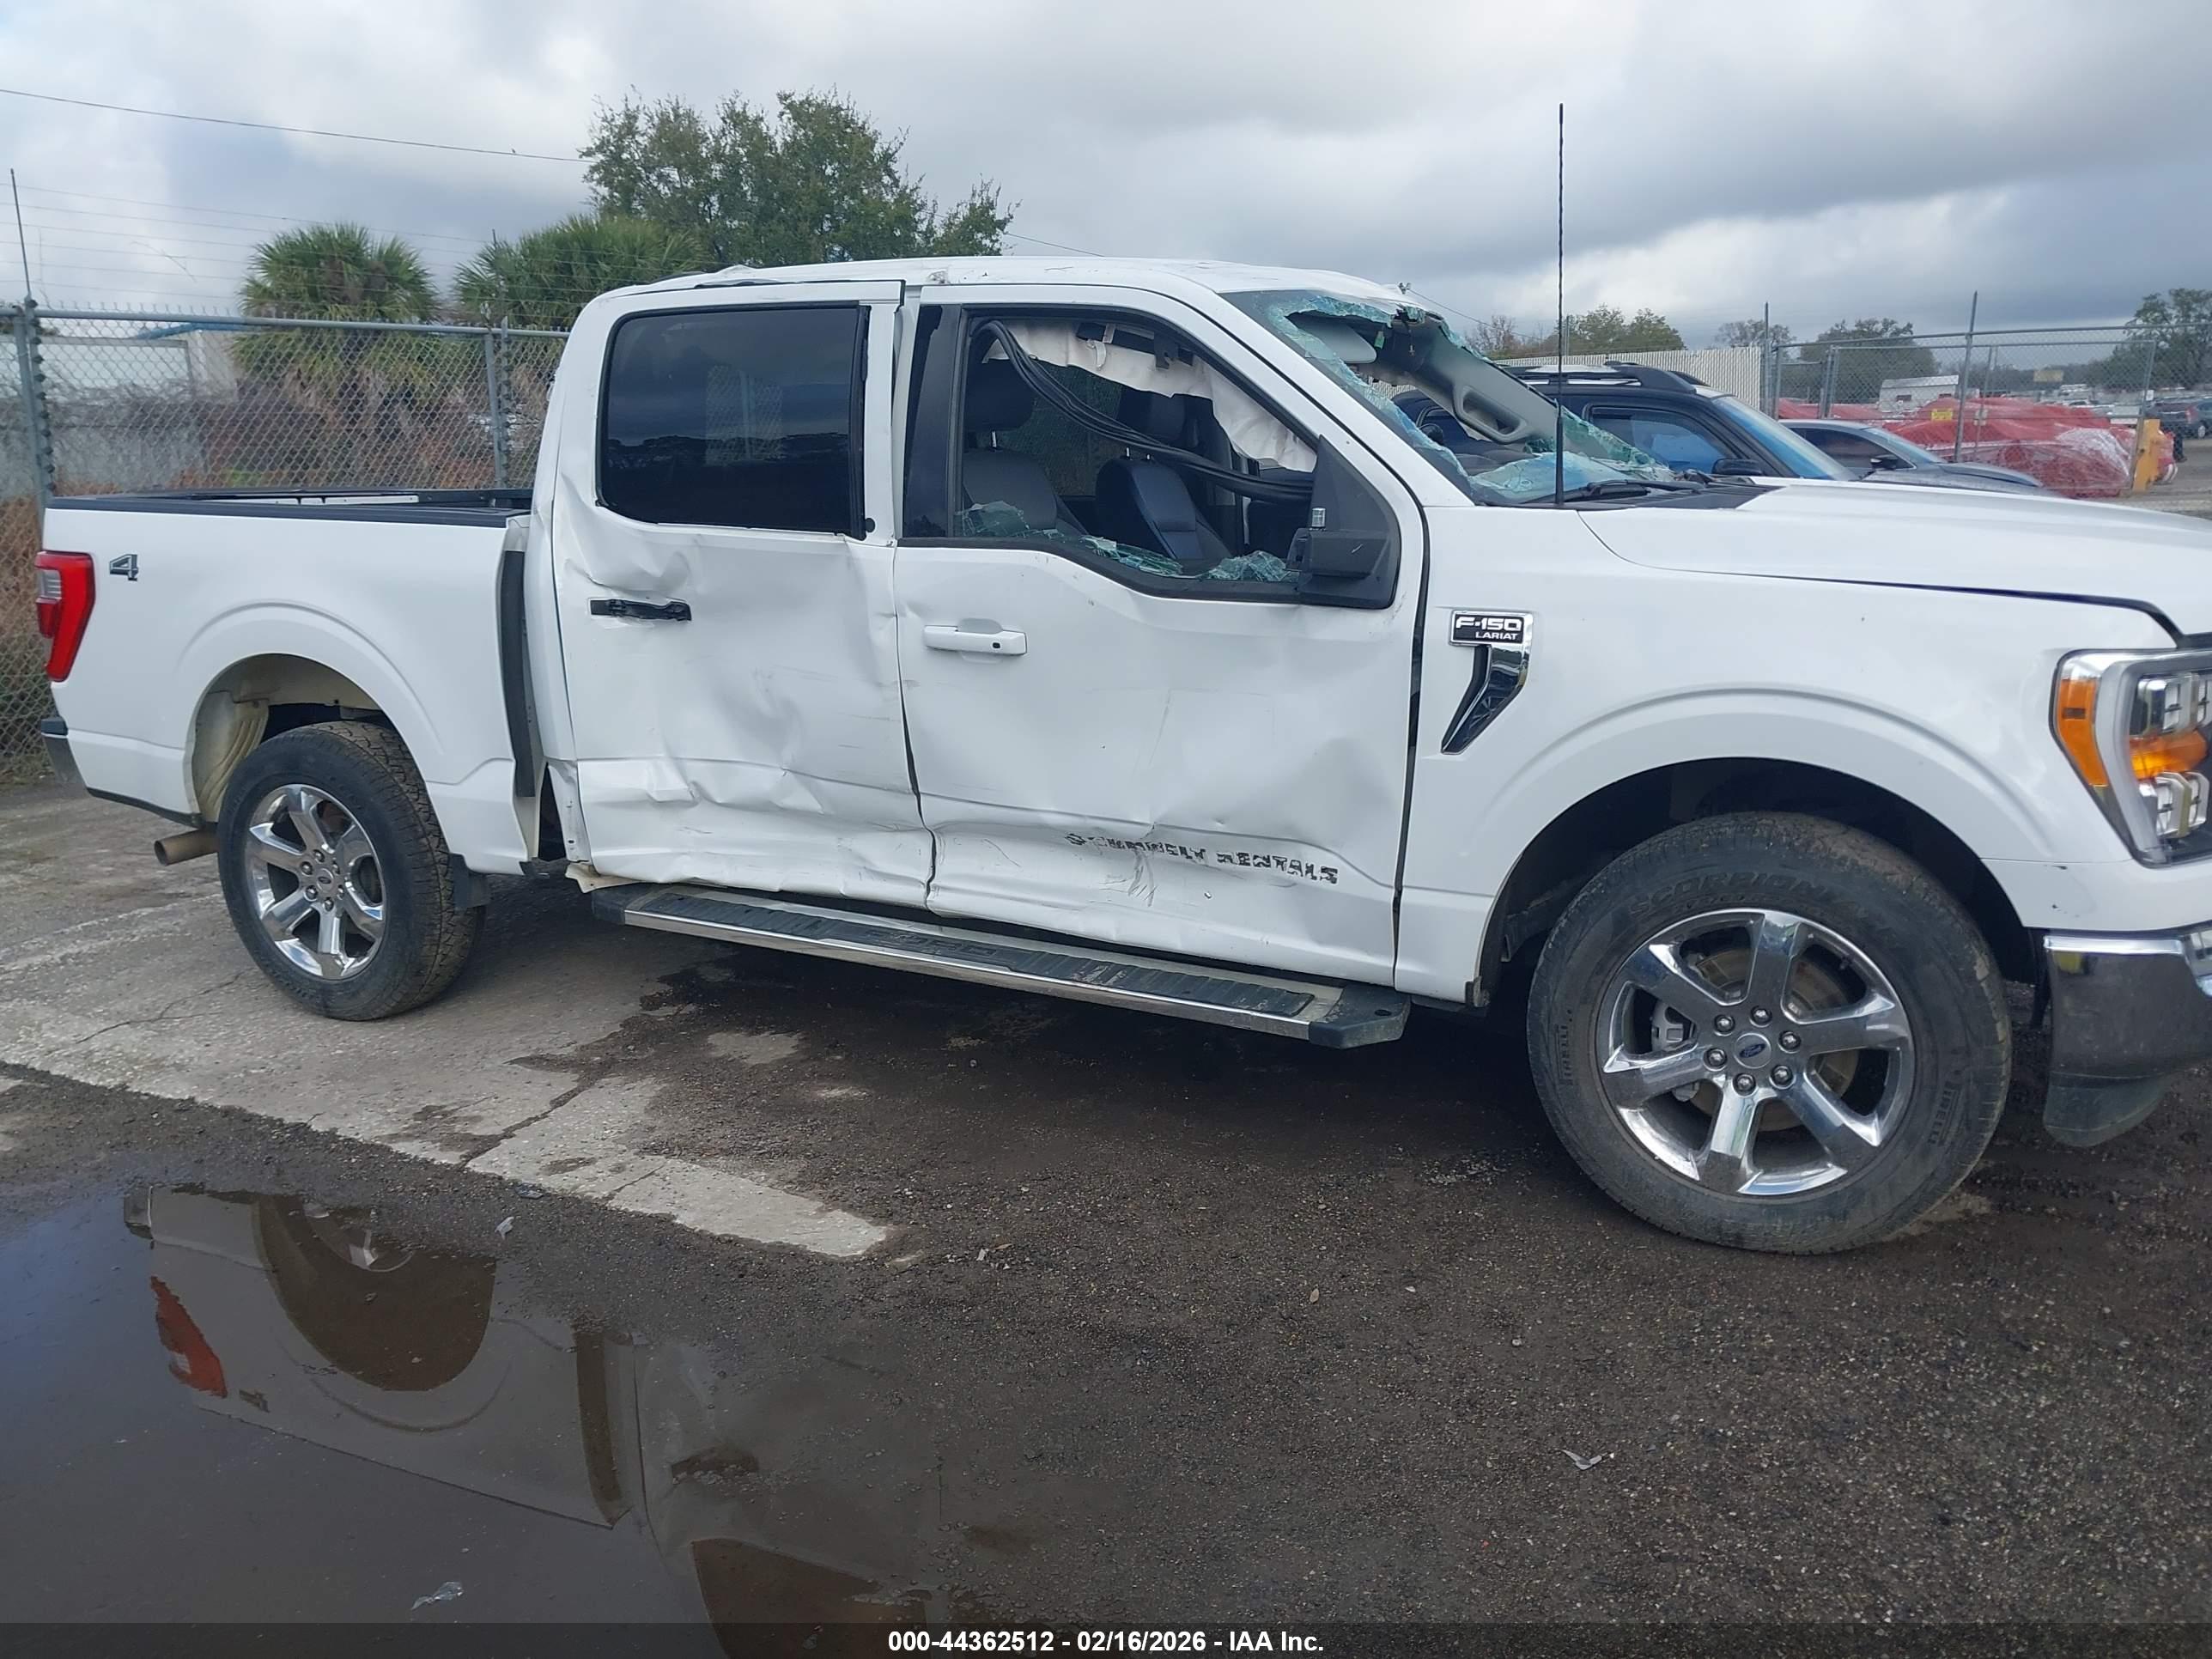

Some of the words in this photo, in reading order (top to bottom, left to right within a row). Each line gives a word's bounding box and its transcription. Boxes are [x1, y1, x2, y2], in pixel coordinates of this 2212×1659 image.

[109, 553, 139, 582] 4
[1455, 616, 1522, 631] F-150
[1475, 631, 1518, 640] LARIAT
